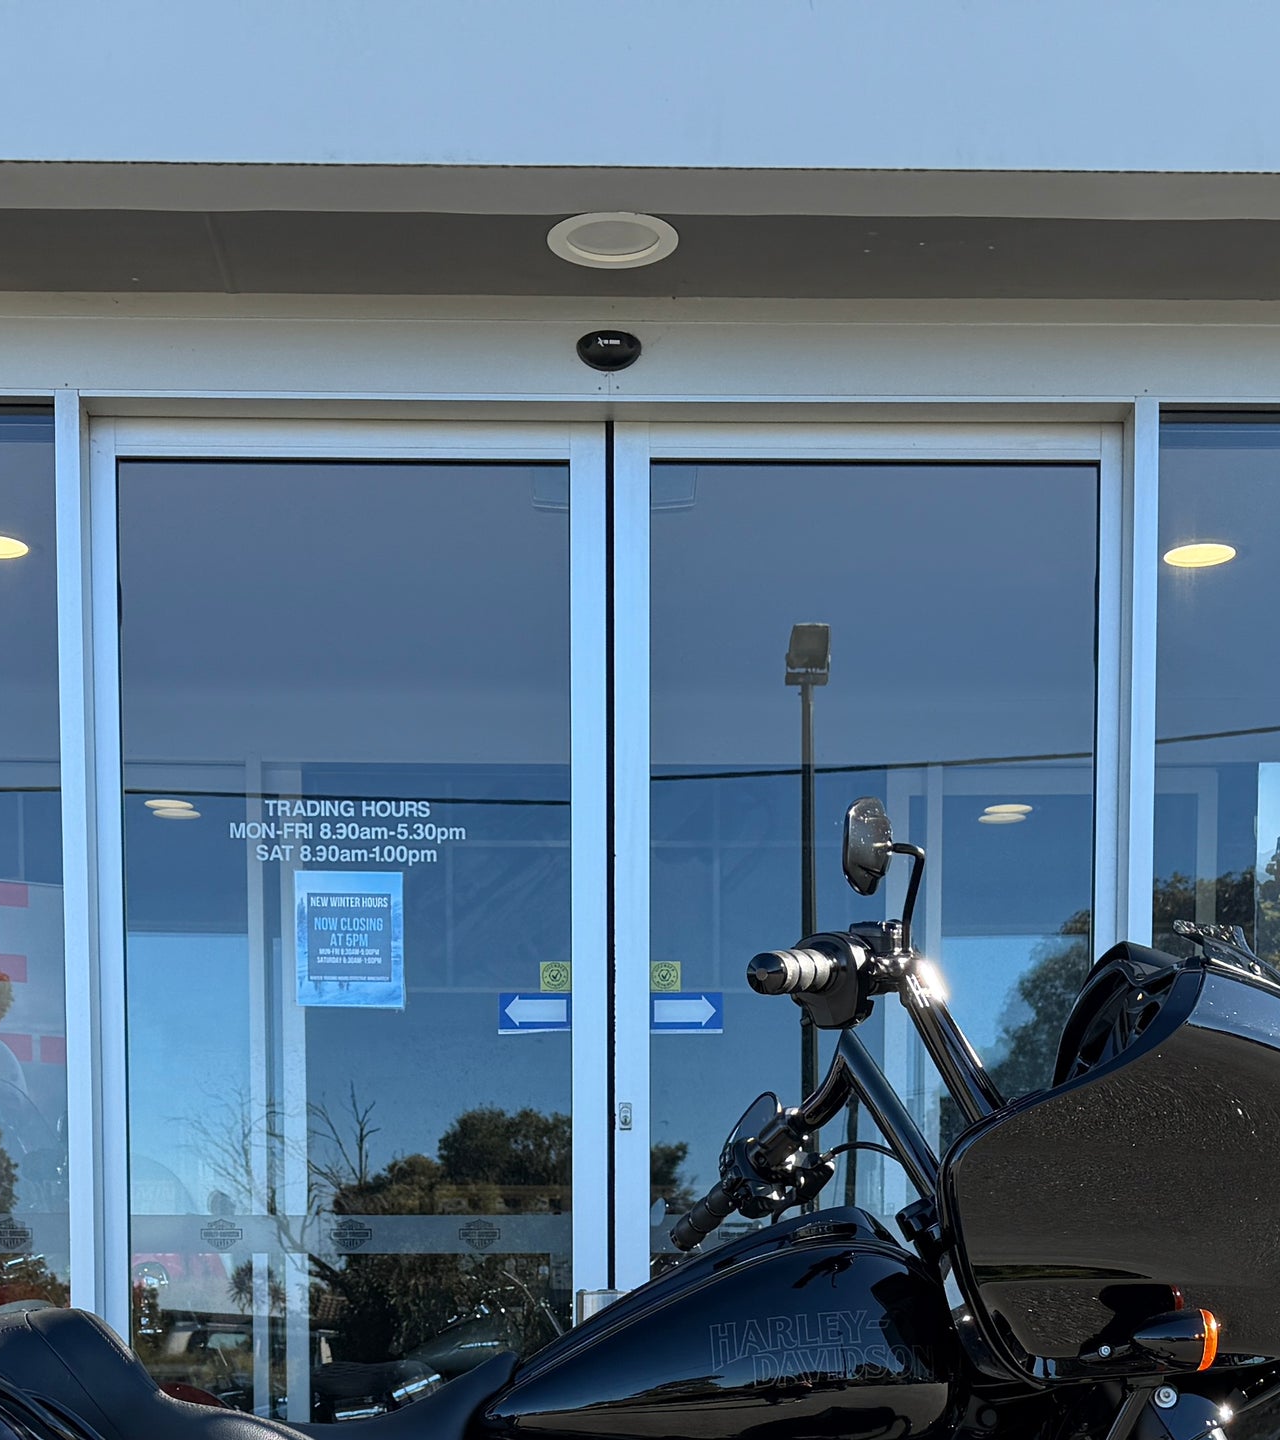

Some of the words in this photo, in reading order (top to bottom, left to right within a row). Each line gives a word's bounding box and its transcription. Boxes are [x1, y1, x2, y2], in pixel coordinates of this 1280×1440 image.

[264, 800, 355, 818] TRADING
[361, 801, 431, 818] HOURS
[229, 822, 314, 839] MON-FRI
[256, 845, 294, 862] SAT
[310, 896, 329, 907] NEW
[329, 897, 360, 908] WINTER
[361, 897, 389, 908] HOURS
[314, 917, 338, 931] NOW
[340, 917, 383, 931] CLOSING
[329, 933, 344, 946] AT
[345, 933, 369, 947] 5PM
[752, 1344, 935, 1386] DAVIDSON
